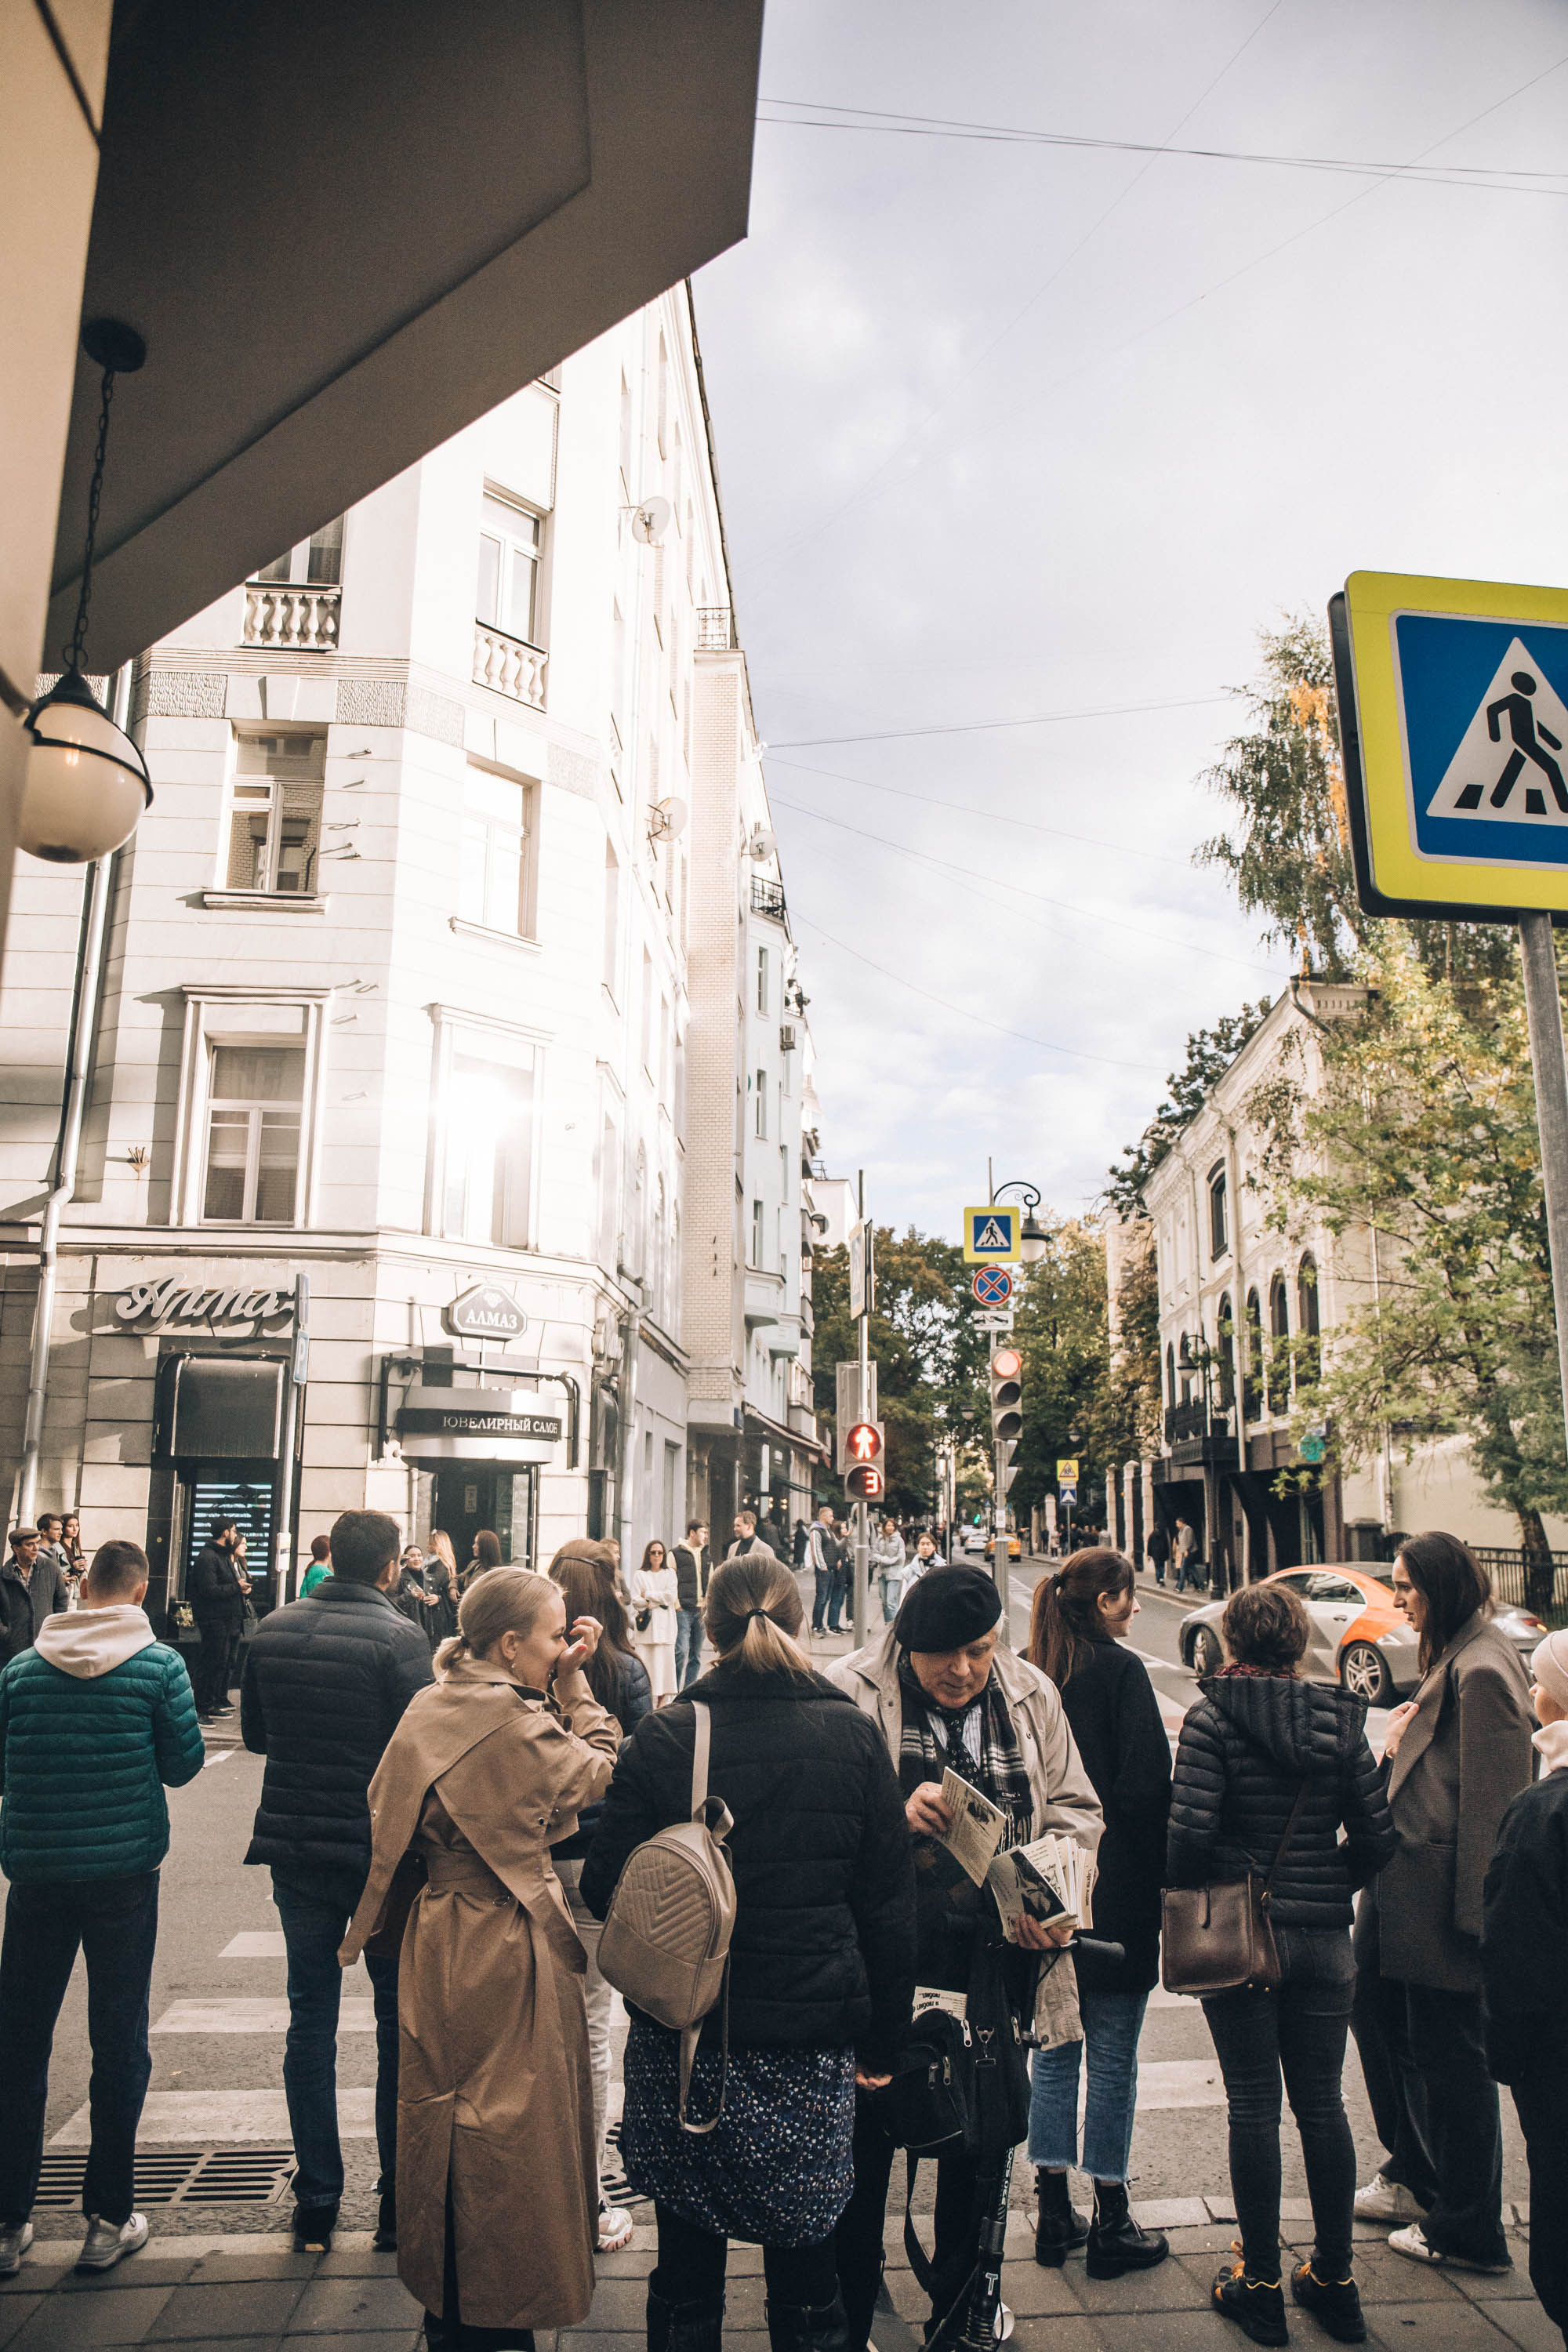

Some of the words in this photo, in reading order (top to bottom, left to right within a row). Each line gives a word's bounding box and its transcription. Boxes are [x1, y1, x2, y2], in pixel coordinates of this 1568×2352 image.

[465, 1308, 517, 1330] АЛМАЗ
[442, 1416, 531, 1432] ЮВЕЛИРНЫЙ
[532, 1420, 557, 1434] САЛОН
[865, 1472, 879, 1494] 3
